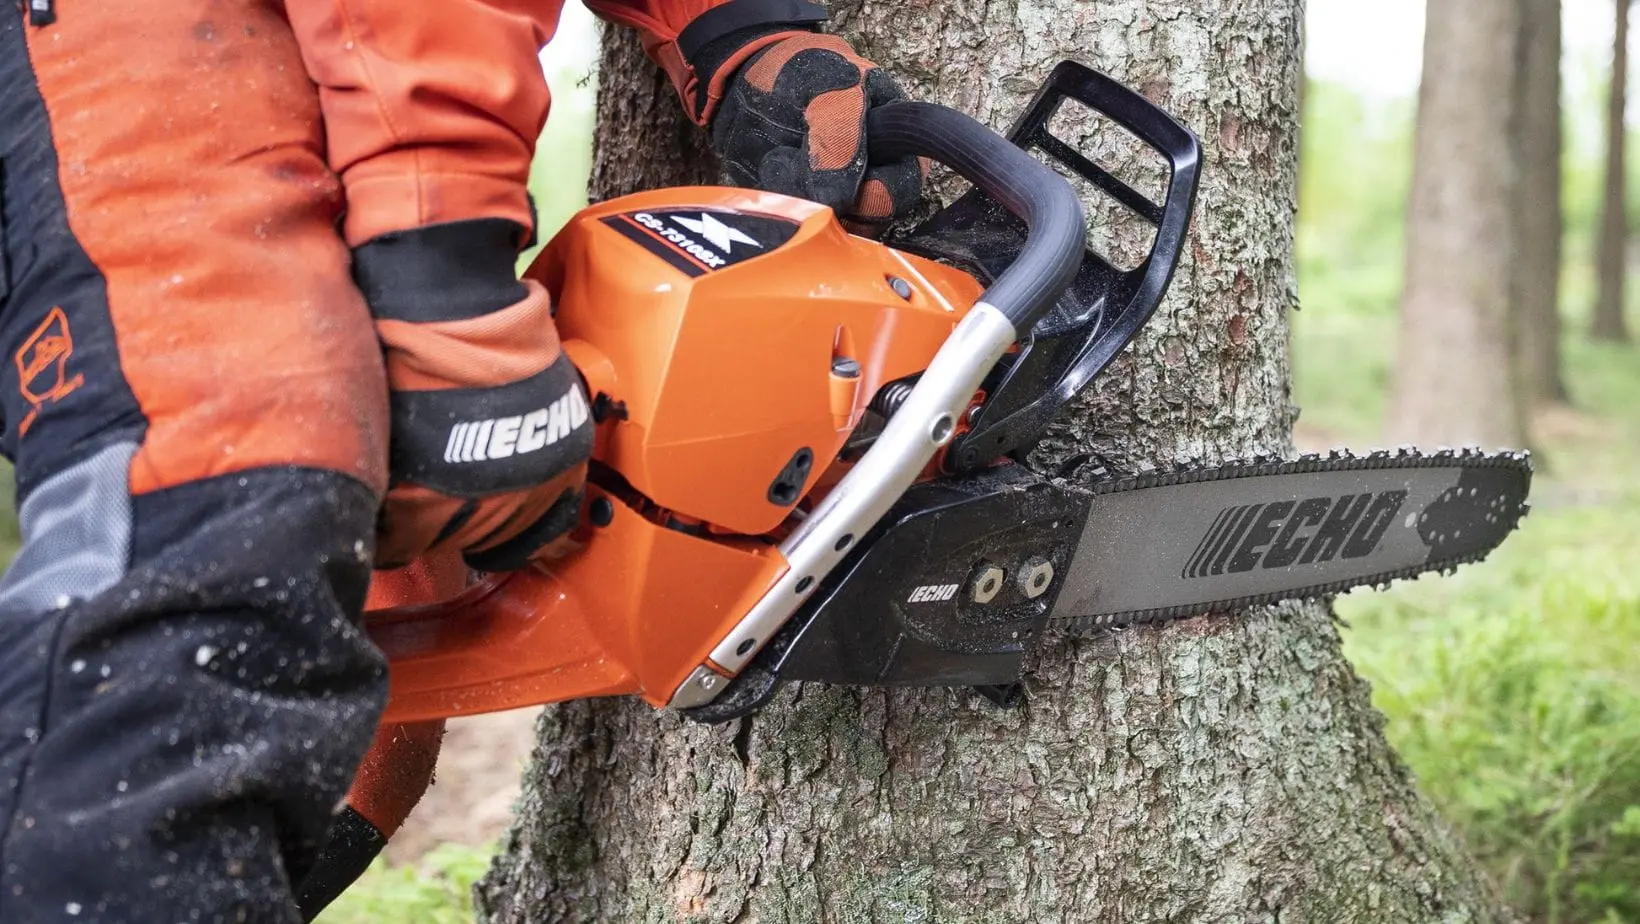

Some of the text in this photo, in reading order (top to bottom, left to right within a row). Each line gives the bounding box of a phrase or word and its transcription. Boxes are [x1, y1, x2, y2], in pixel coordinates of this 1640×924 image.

[487, 382, 588, 460] ECHO
[1226, 489, 1408, 574] ECHO
[915, 584, 959, 602] ECHO
